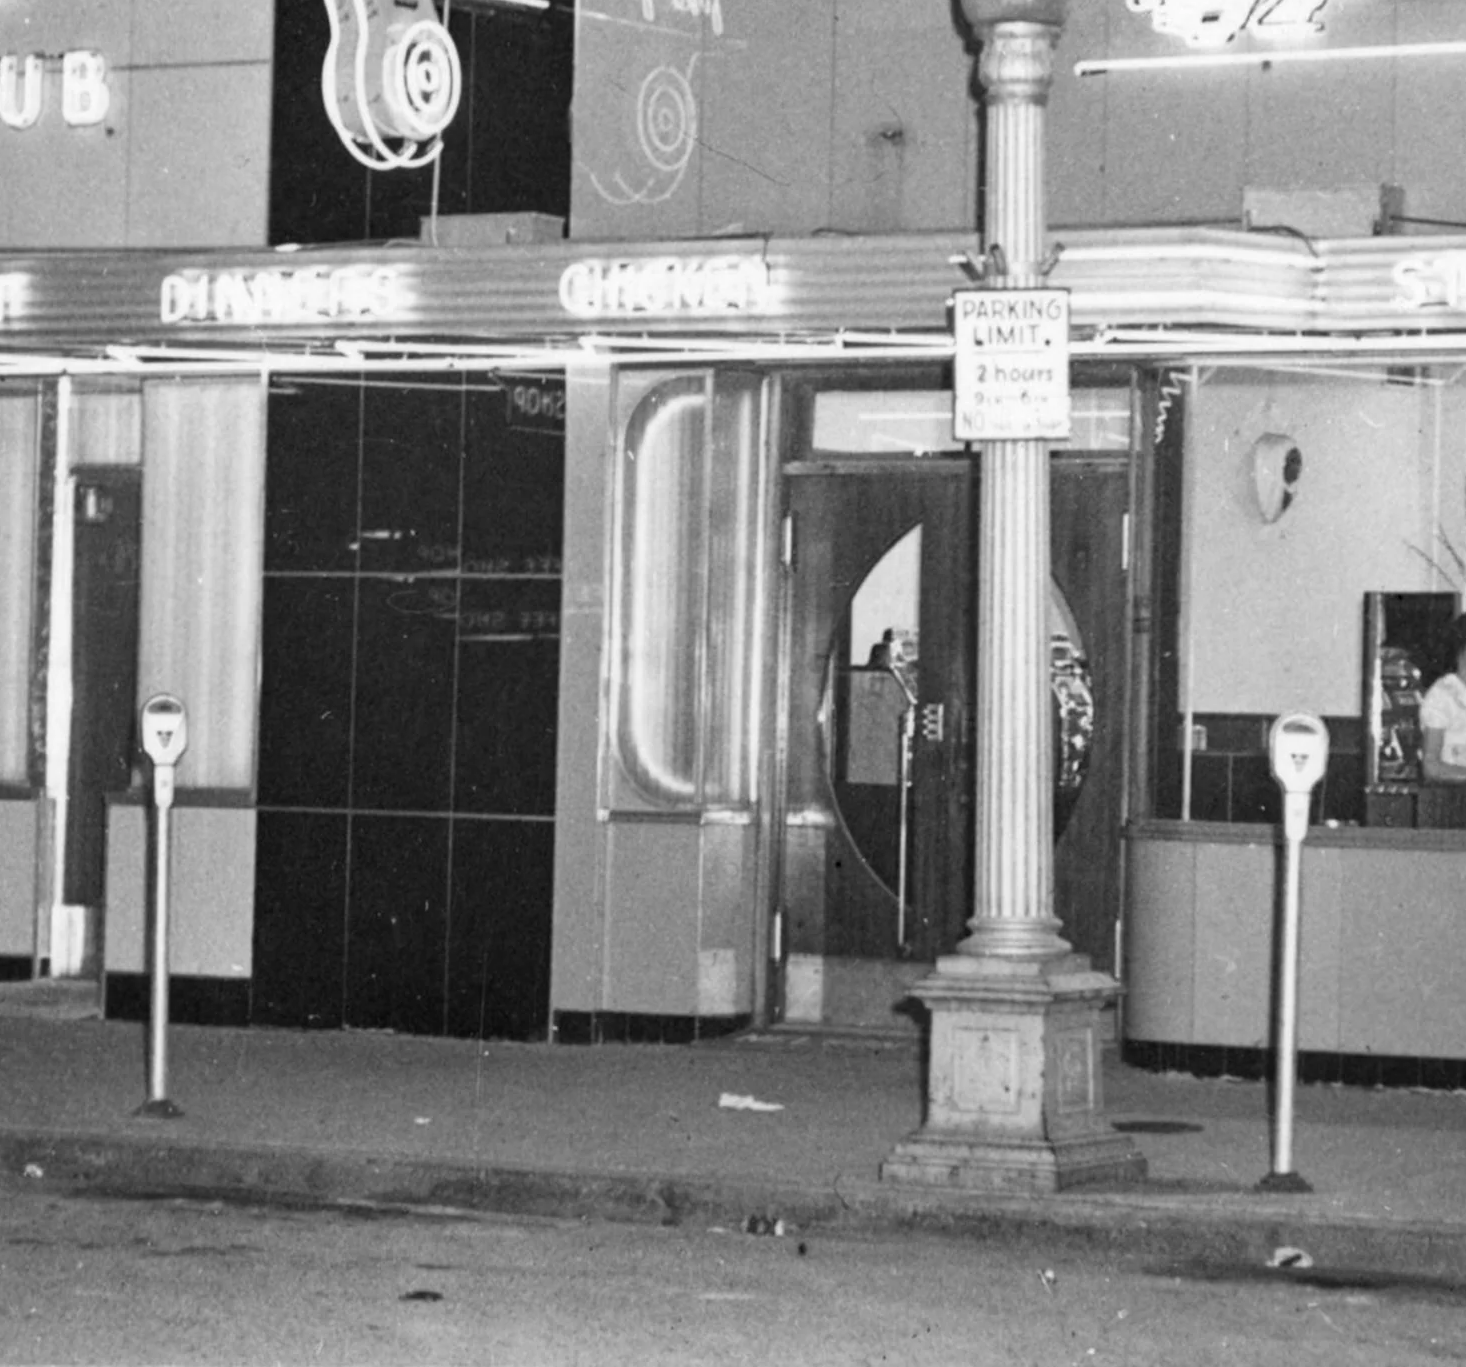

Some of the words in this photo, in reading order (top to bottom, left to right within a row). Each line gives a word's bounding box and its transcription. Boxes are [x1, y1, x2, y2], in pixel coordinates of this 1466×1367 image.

[161, 266, 403, 322] DINNERS
[559, 255, 771, 316] CHICKEN
[962, 299, 1062, 321] PARKING
[976, 363, 987, 384] 2
[994, 365, 1053, 383] hours
